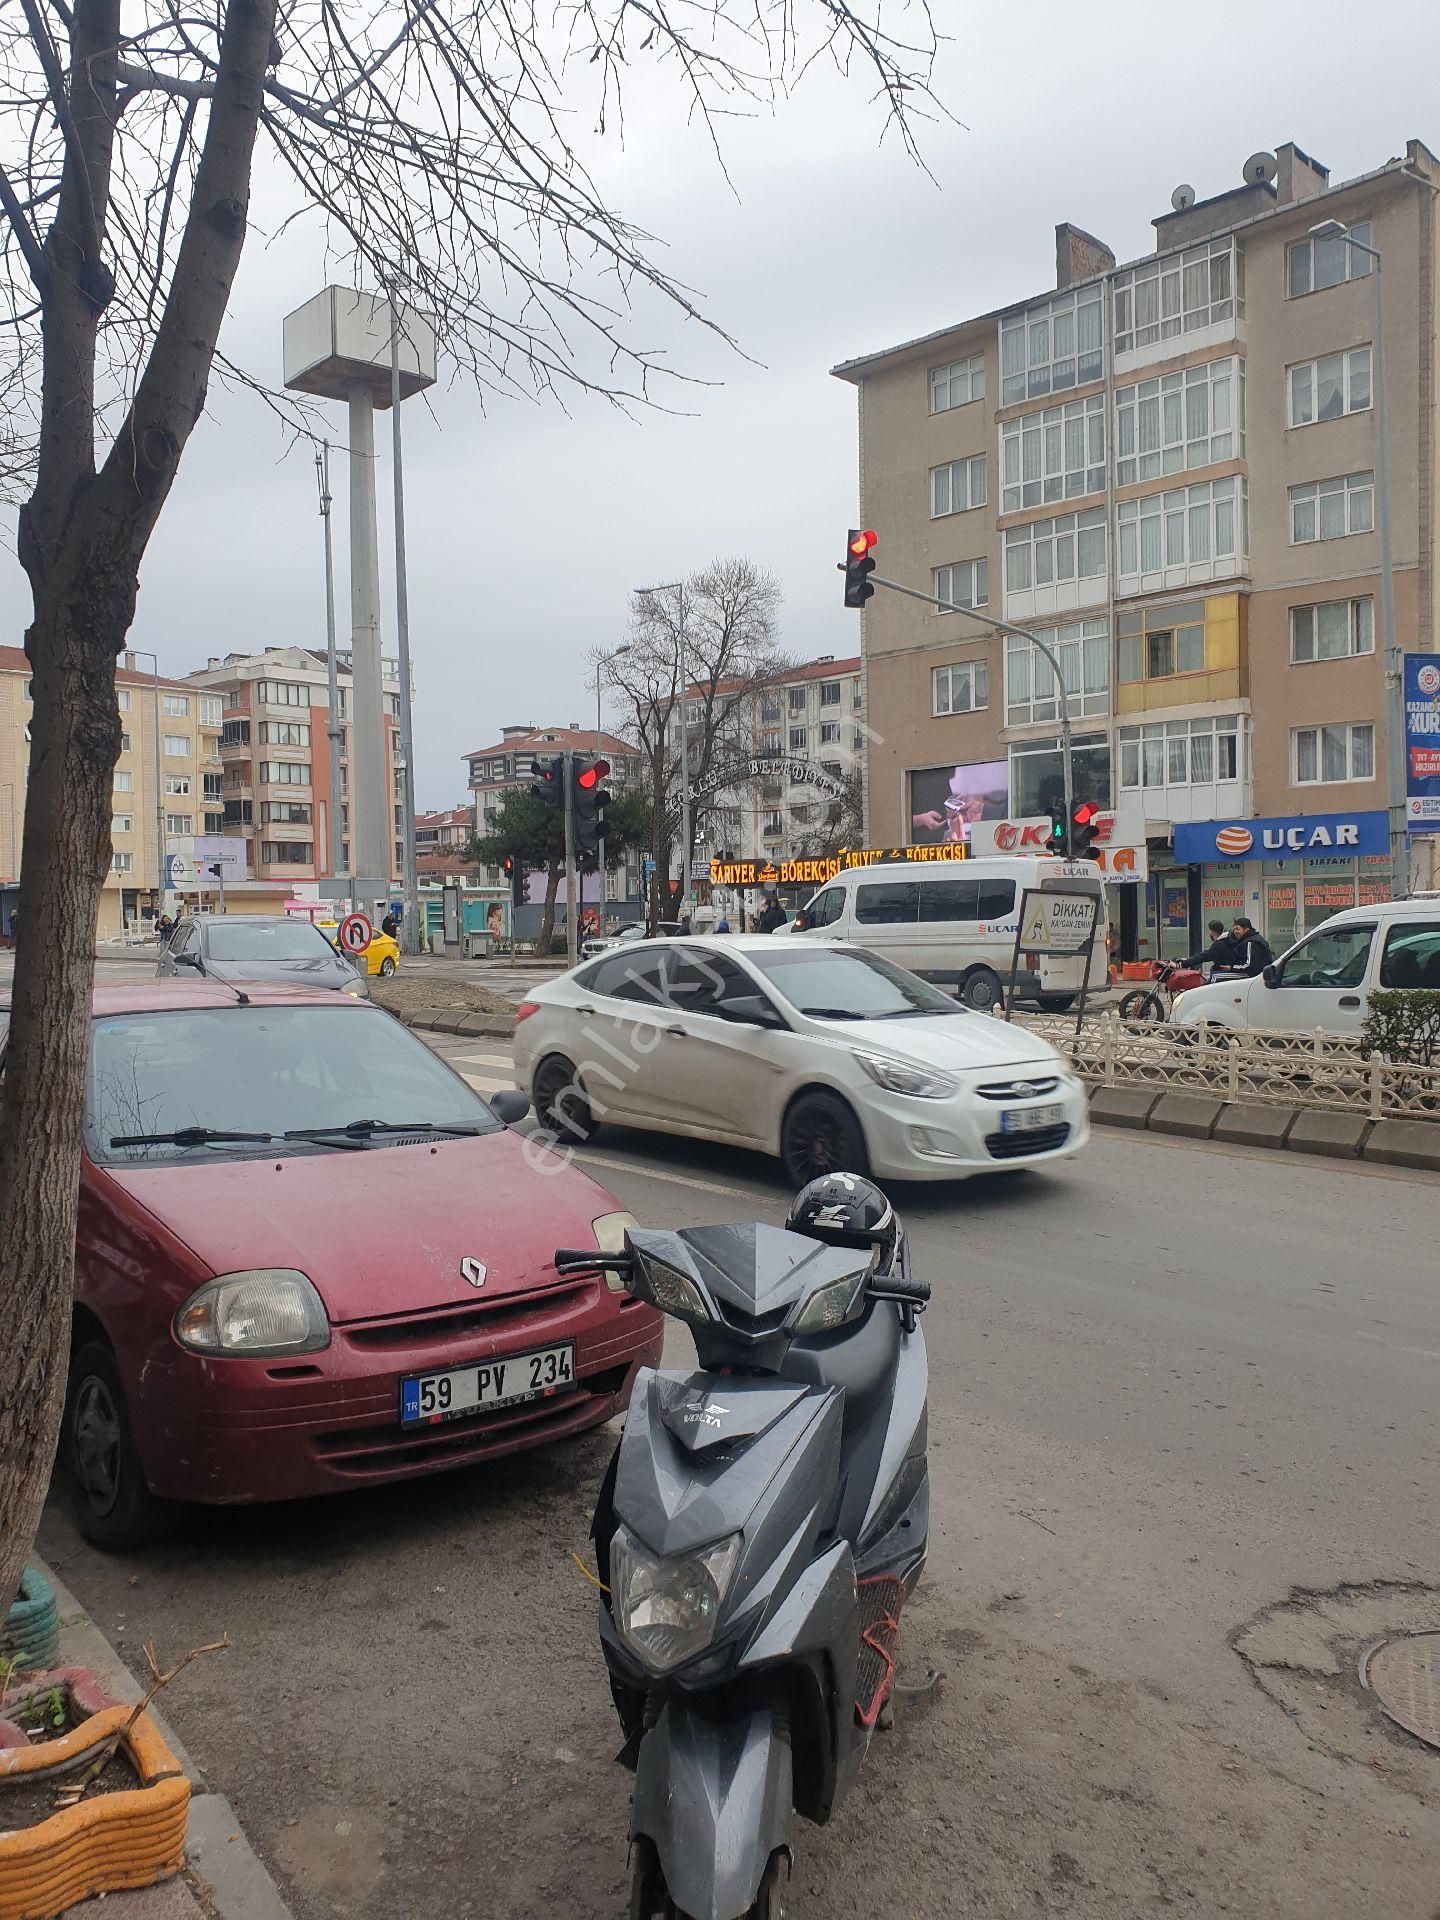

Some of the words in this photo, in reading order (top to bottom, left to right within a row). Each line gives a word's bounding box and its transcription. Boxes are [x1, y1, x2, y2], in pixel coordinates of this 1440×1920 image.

[1263, 824, 1360, 851] UÇAR
[710, 862, 756, 885] SARIYER
[781, 857, 842, 883] BÖREKÇİSİ
[1053, 900, 1094, 918] DİKKAT!
[406, 1402, 418, 1412] TR
[421, 1377, 452, 1412] 59
[477, 1365, 505, 1400] PV
[529, 1350, 571, 1389] 234
[683, 1414, 721, 1428] VOLTA
